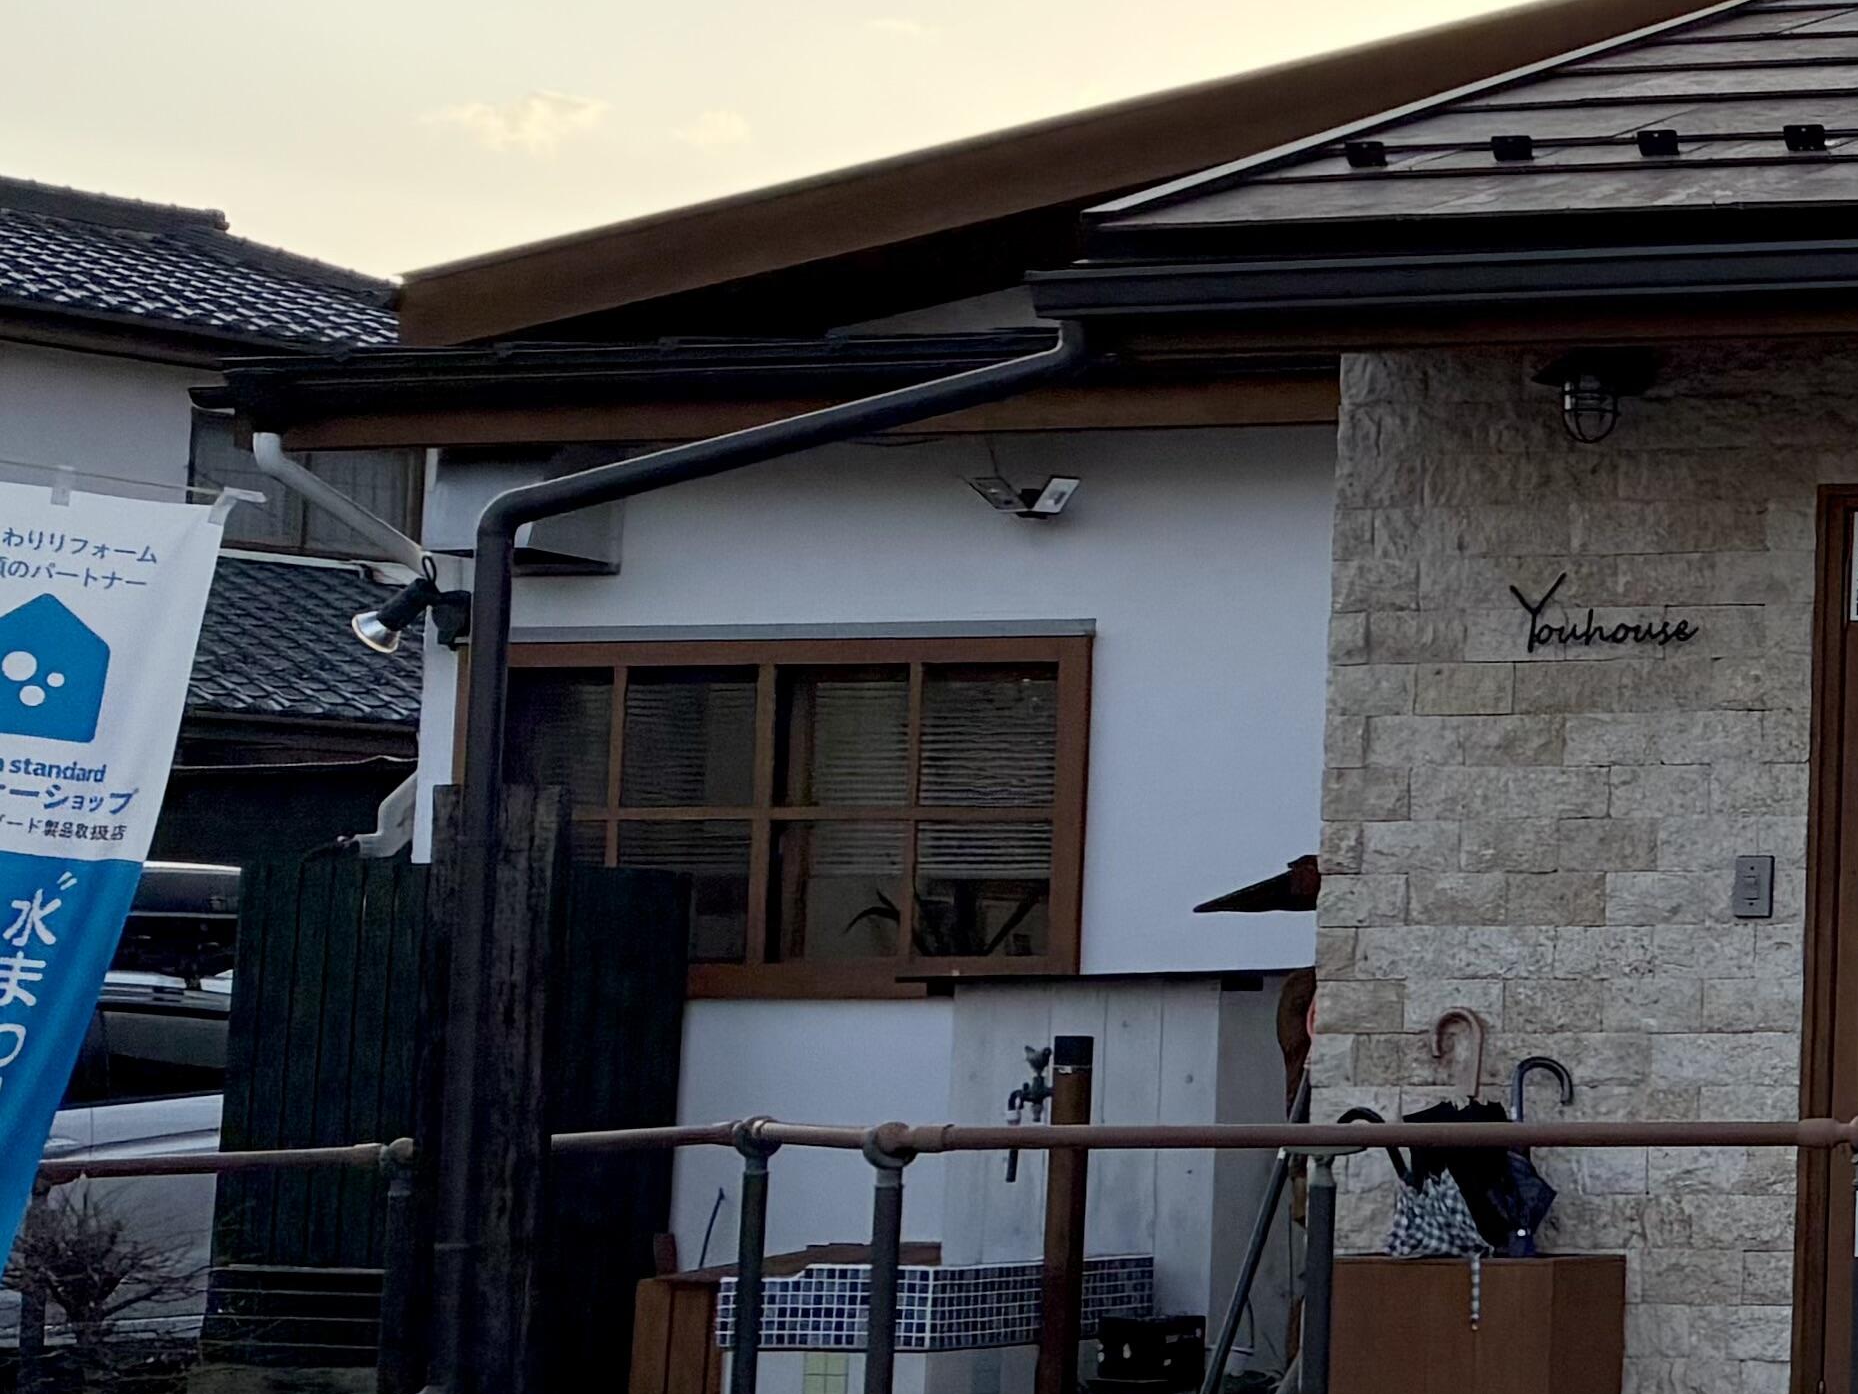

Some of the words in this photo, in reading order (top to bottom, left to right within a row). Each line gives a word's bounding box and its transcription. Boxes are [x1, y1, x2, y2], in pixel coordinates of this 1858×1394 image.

[9, 758, 107, 783] standard
[0, 784, 139, 815] ーショップ
[0, 814, 128, 841] ード製品取扱店
